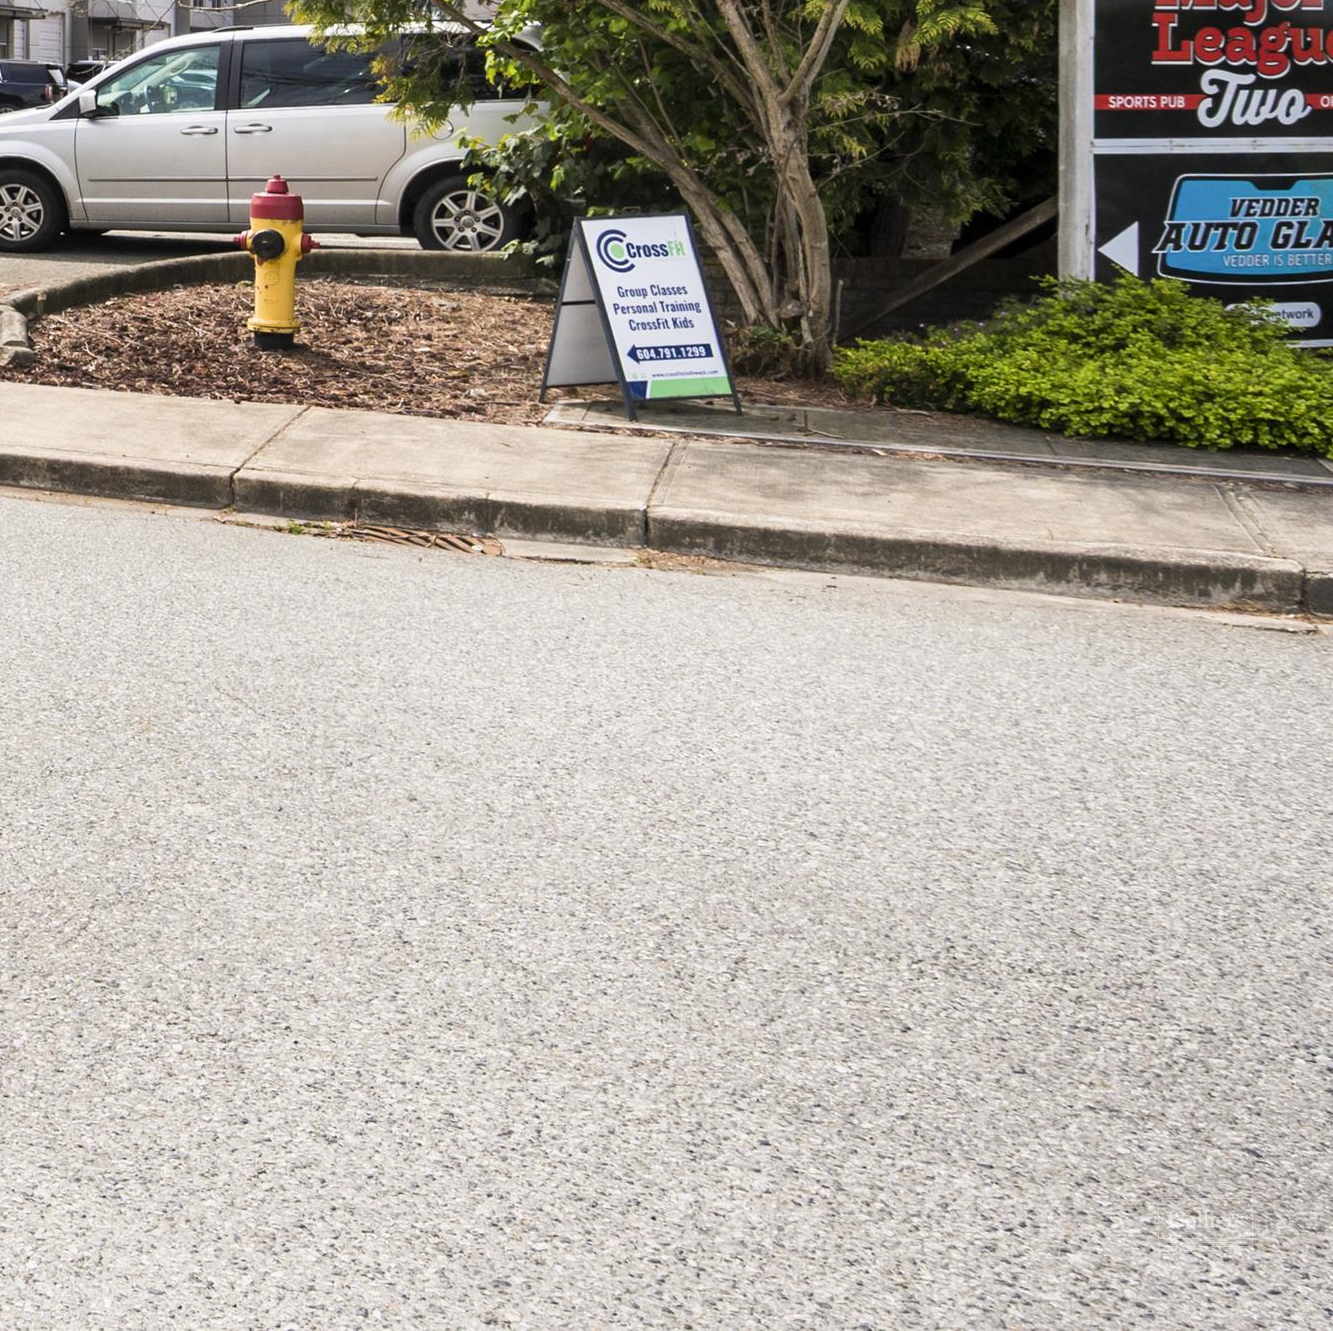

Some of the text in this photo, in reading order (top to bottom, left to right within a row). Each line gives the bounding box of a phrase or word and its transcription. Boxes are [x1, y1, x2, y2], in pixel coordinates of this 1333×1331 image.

[1151, 12, 1333, 79] Leagu
[1108, 96, 1185, 108] SPORTS PUB
[1197, 68, 1312, 128] Two
[1229, 197, 1320, 218] VEDDER
[1152, 220, 1259, 253] AUTO
[626, 240, 686, 258] CrossFit
[1223, 253, 1332, 267] VEDDER IS BETTER
[617, 284, 688, 299] Group Classes
[613, 300, 702, 315] Personal Training
[629, 316, 694, 331] CrossFit Kids
[636, 346, 706, 360] 604.791.1299
